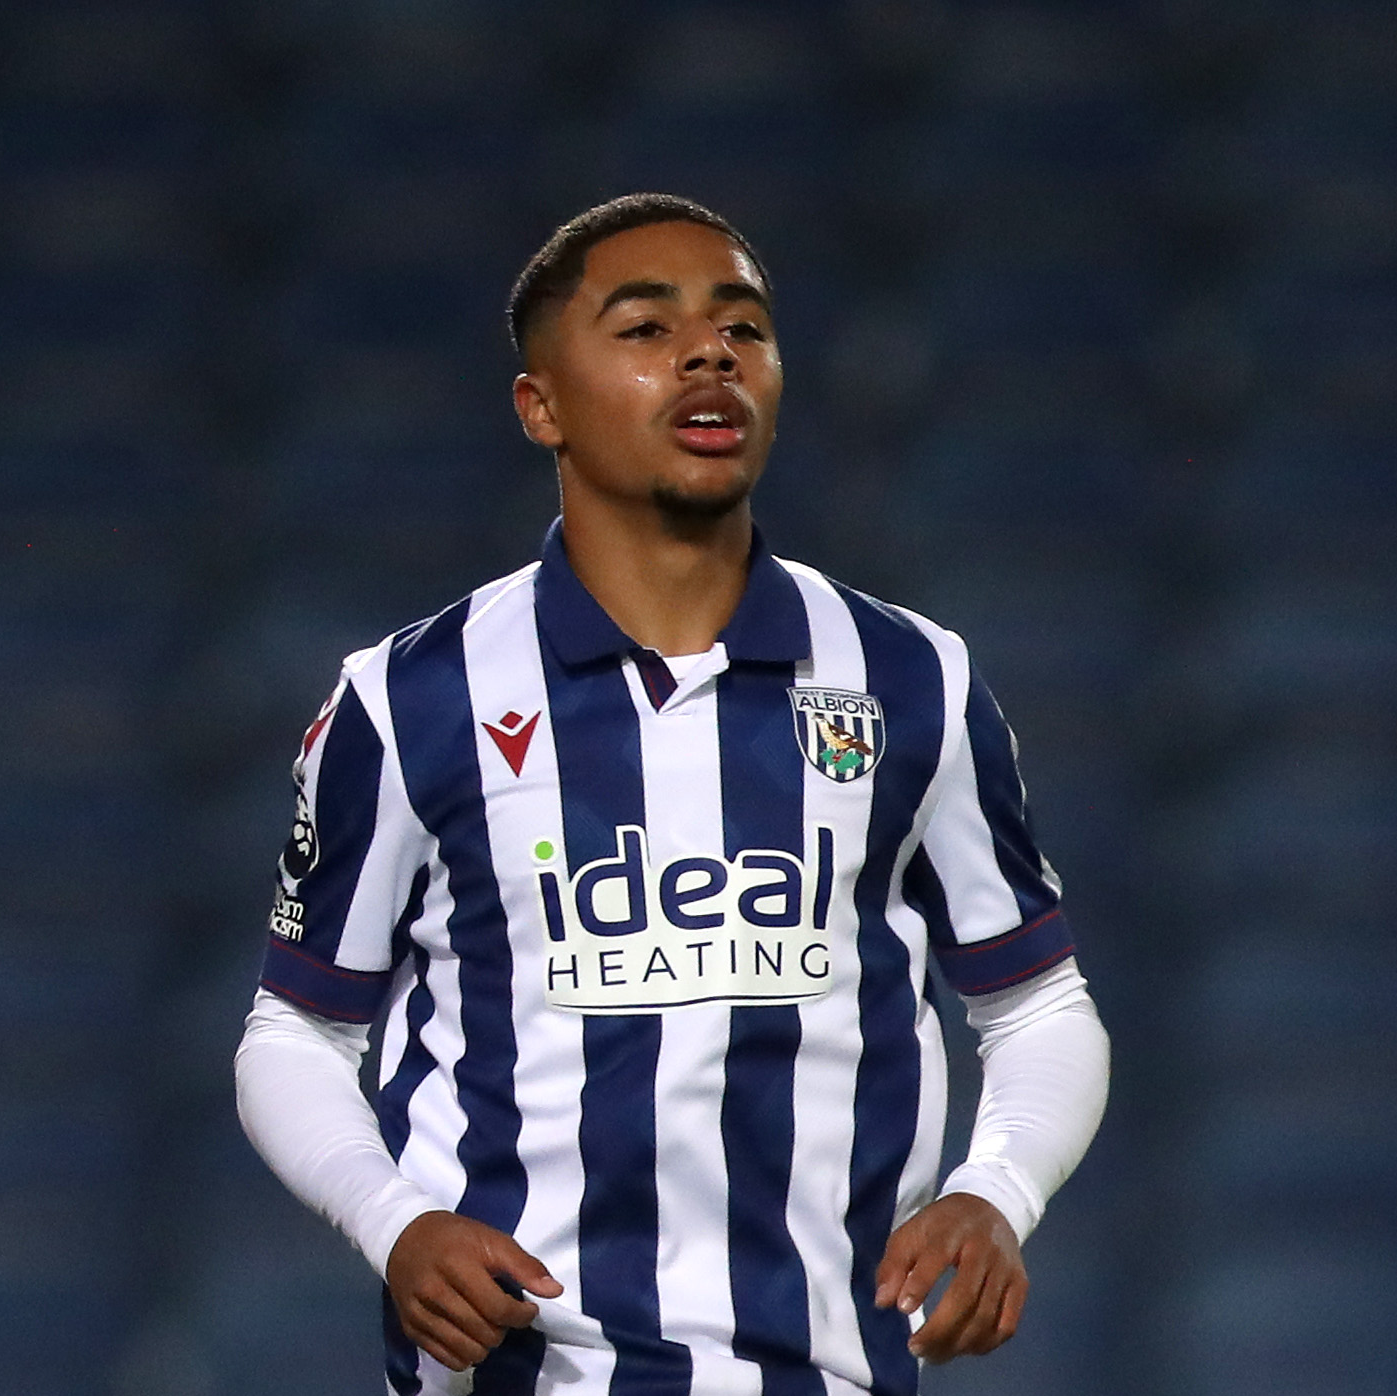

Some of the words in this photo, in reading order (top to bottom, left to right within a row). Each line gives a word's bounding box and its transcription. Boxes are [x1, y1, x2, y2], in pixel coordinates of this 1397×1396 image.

[799, 696, 876, 716] ALBION
[535, 827, 833, 942] ideal
[548, 939, 830, 991] HEATING
